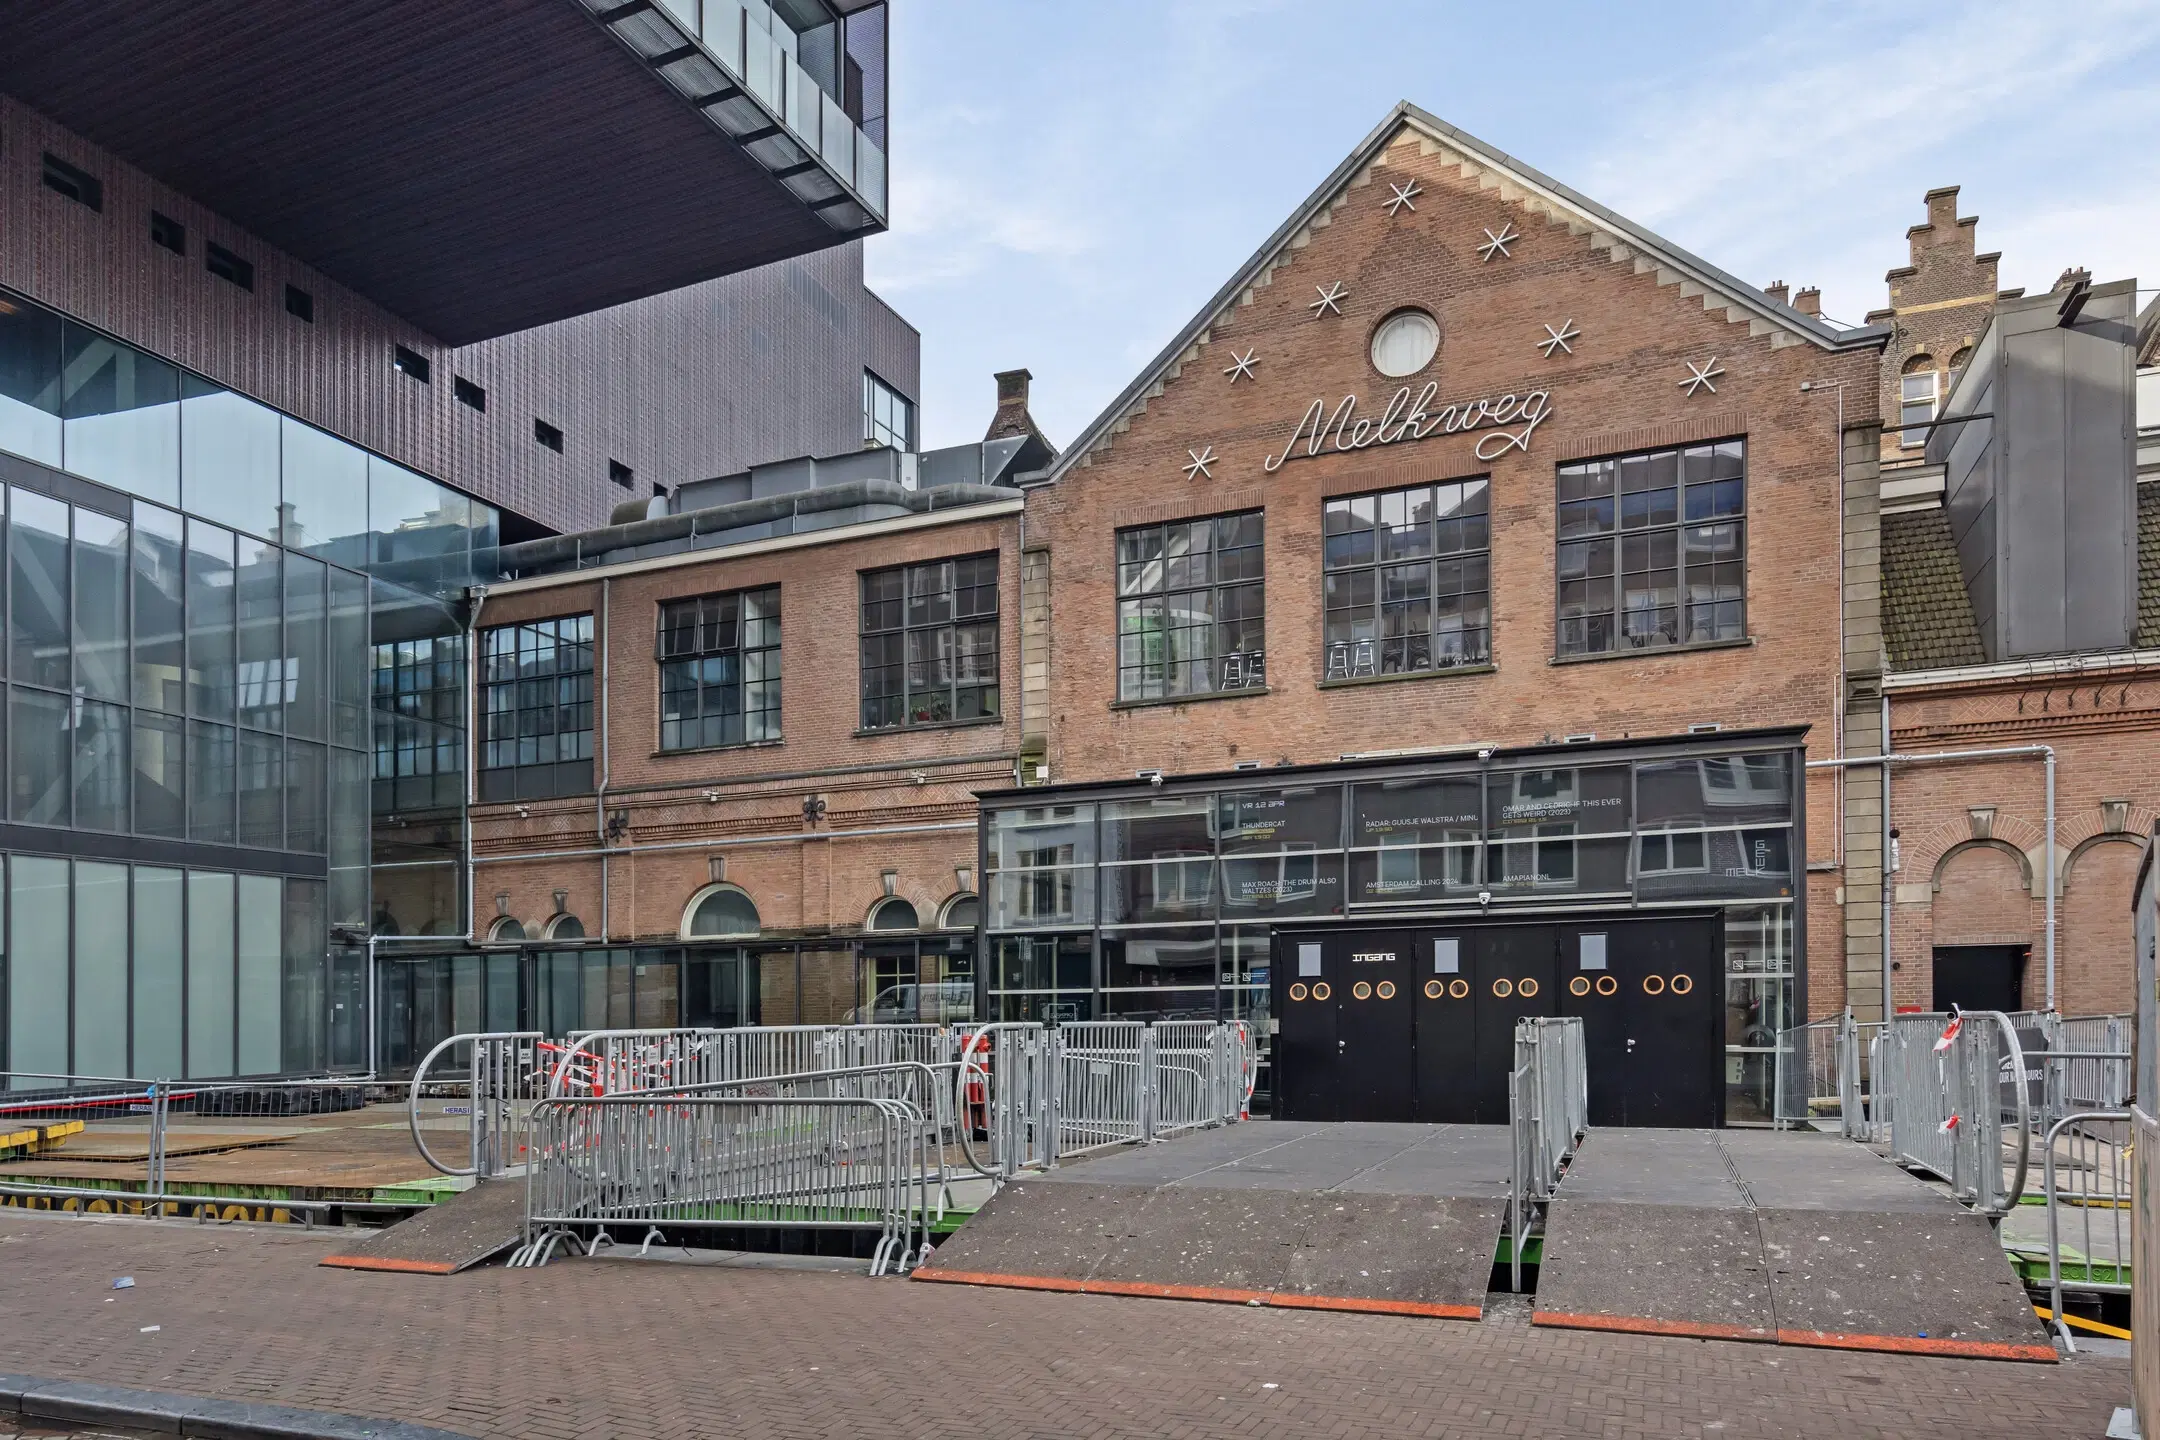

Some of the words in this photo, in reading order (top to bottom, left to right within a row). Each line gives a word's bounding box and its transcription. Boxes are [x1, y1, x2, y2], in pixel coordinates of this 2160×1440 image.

[1264, 381, 1552, 472] Melkweg
[1526, 803, 1542, 811] AND
[1502, 811, 1522, 819] GETS
[1523, 810, 1547, 818] WEIRD
[1548, 808, 1571, 816] (2023)
[1242, 821, 1286, 829] THUNDERCAT
[1365, 820, 1391, 828] RADAR:
[1391, 818, 1419, 826] GUUSJE
[1421, 816, 1454, 825] WALSTRA
[1318, 877, 1337, 885] ALSO
[1365, 880, 1409, 889] AMSTERDAM
[1410, 878, 1441, 887] CALLING
[1442, 877, 1459, 885] 2024
[1999, 1072, 2010, 1084] OUR
